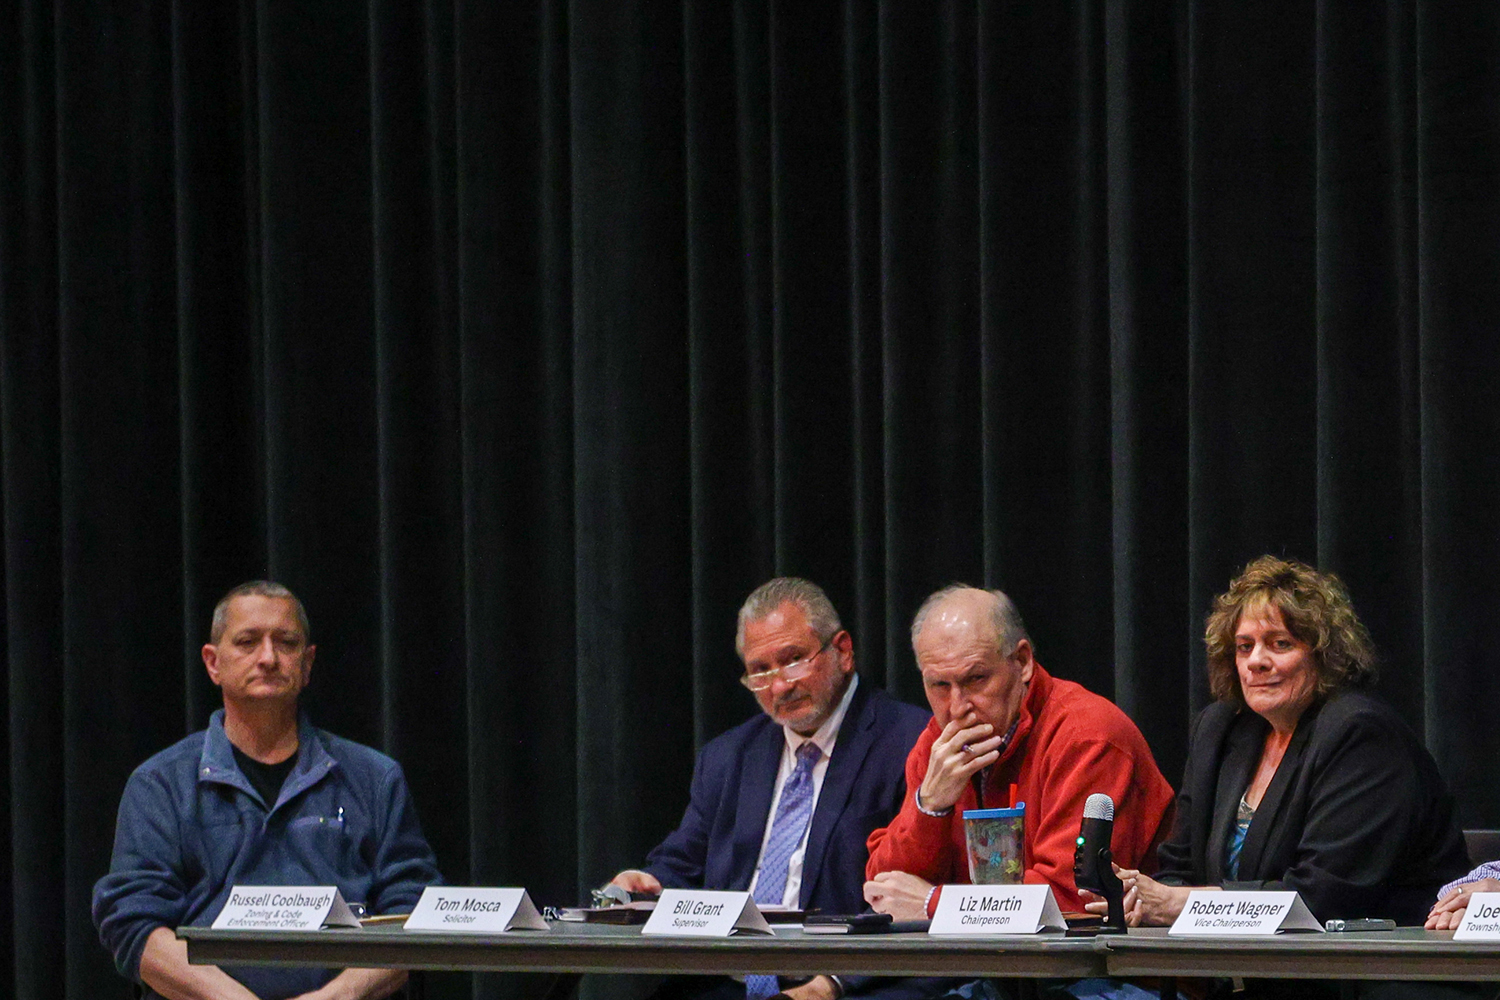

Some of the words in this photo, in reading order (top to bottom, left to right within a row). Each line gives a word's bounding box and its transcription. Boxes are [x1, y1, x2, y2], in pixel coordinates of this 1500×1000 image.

[229, 893, 271, 907] Russell
[271, 893, 331, 910] Coolbaugh
[434, 897, 461, 911] Tom
[461, 898, 501, 912] Mosca
[673, 900, 694, 915] Bill
[693, 901, 724, 916] Grant
[959, 896, 978, 912] Liz
[979, 895, 1023, 912] Martin
[244, 909, 272, 919] Zoning
[281, 910, 303, 919] Code
[1188, 900, 1235, 915] Robert
[1235, 901, 1285, 919] Wagner
[1473, 903, 1500, 919] Joe
[227, 918, 279, 927] Enforcement
[280, 919, 309, 928] Officer
[442, 914, 476, 924] Solicitor
[672, 918, 709, 929] Supervisor
[961, 914, 1011, 927] Chairperson
[1194, 918, 1211, 927] Vice
[1212, 918, 1262, 929] Chairperson
